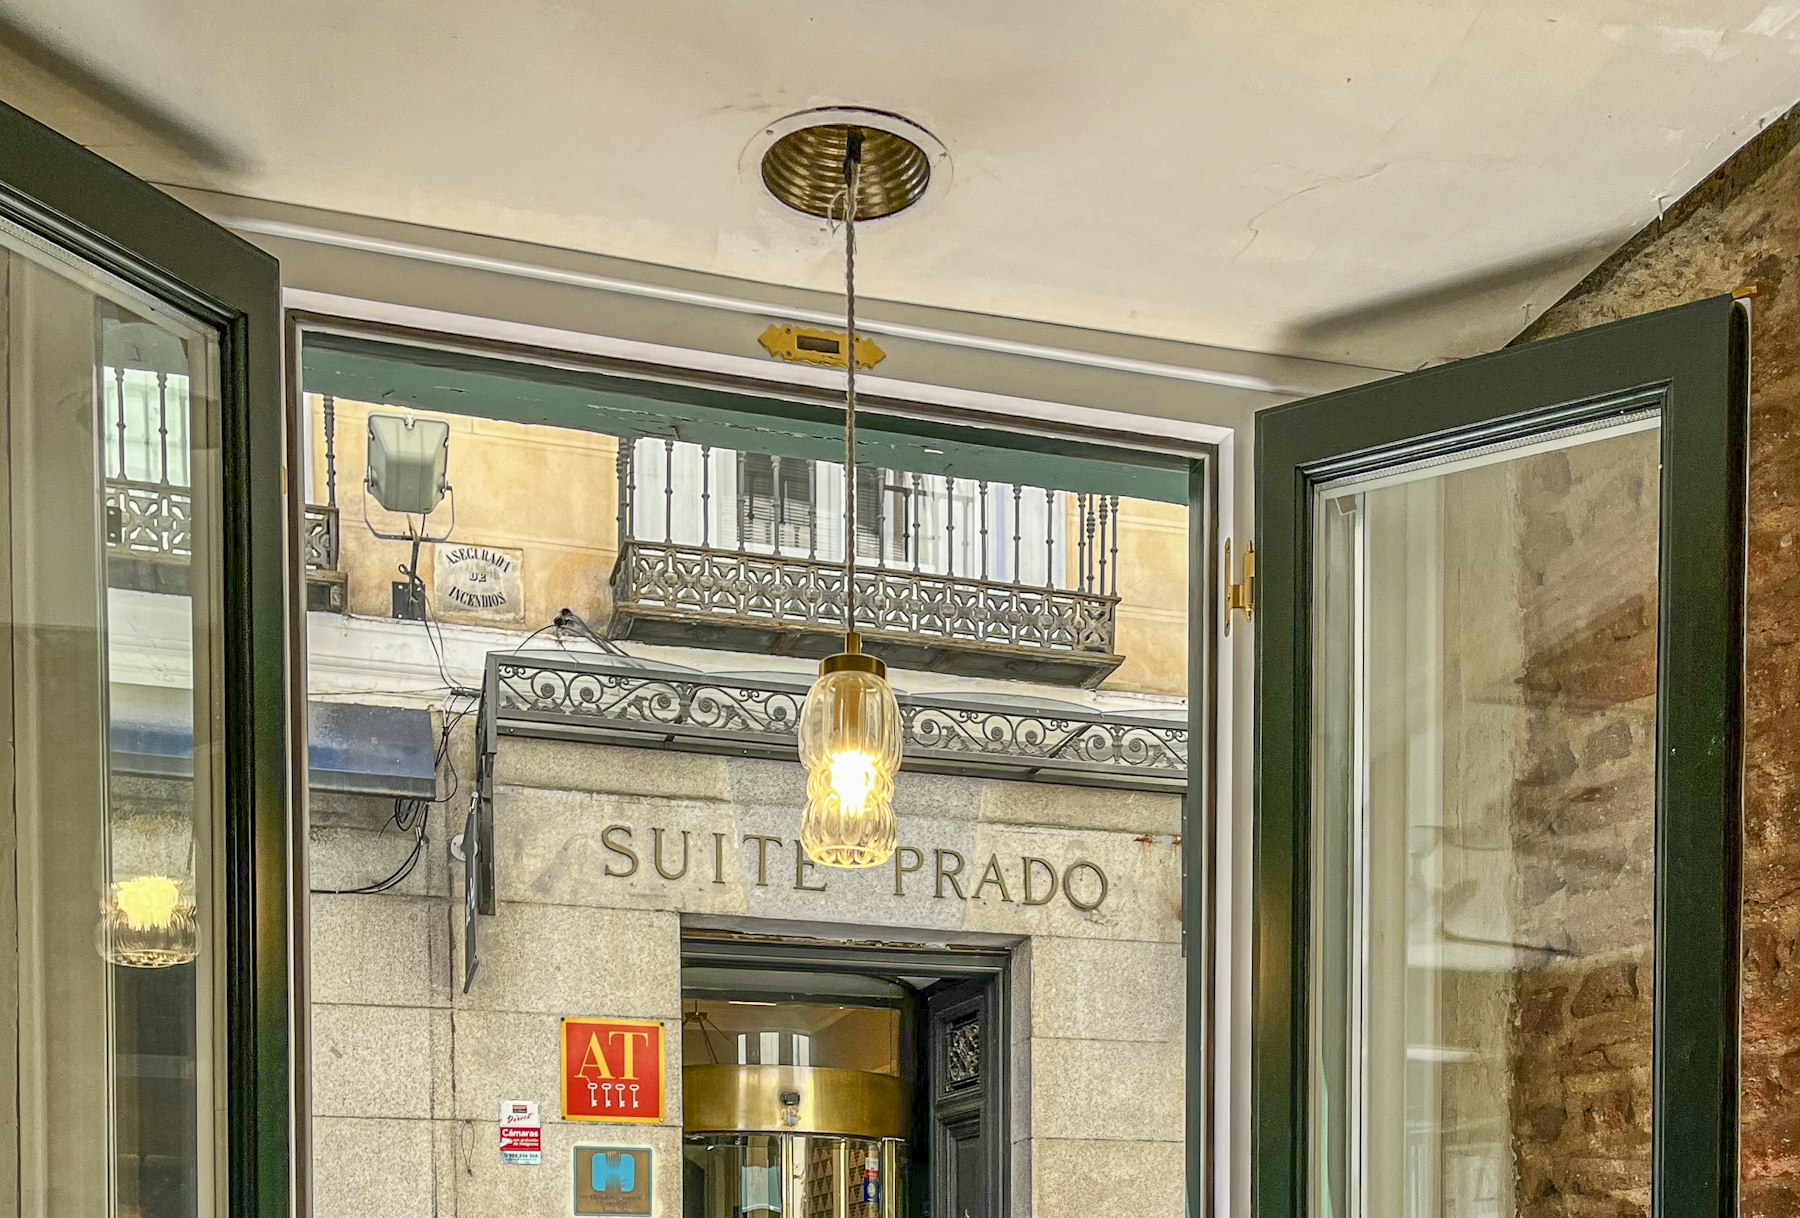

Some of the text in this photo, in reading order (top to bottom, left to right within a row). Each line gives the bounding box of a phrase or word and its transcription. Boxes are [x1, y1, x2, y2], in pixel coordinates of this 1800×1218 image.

[446, 547, 511, 573] ASEGURADA
[448, 586, 507, 608] INCENDIOS
[600, 824, 1109, 910] SUITE PRADO
[573, 1030, 649, 1081] AT
[502, 1129, 539, 1137] Cámaras
